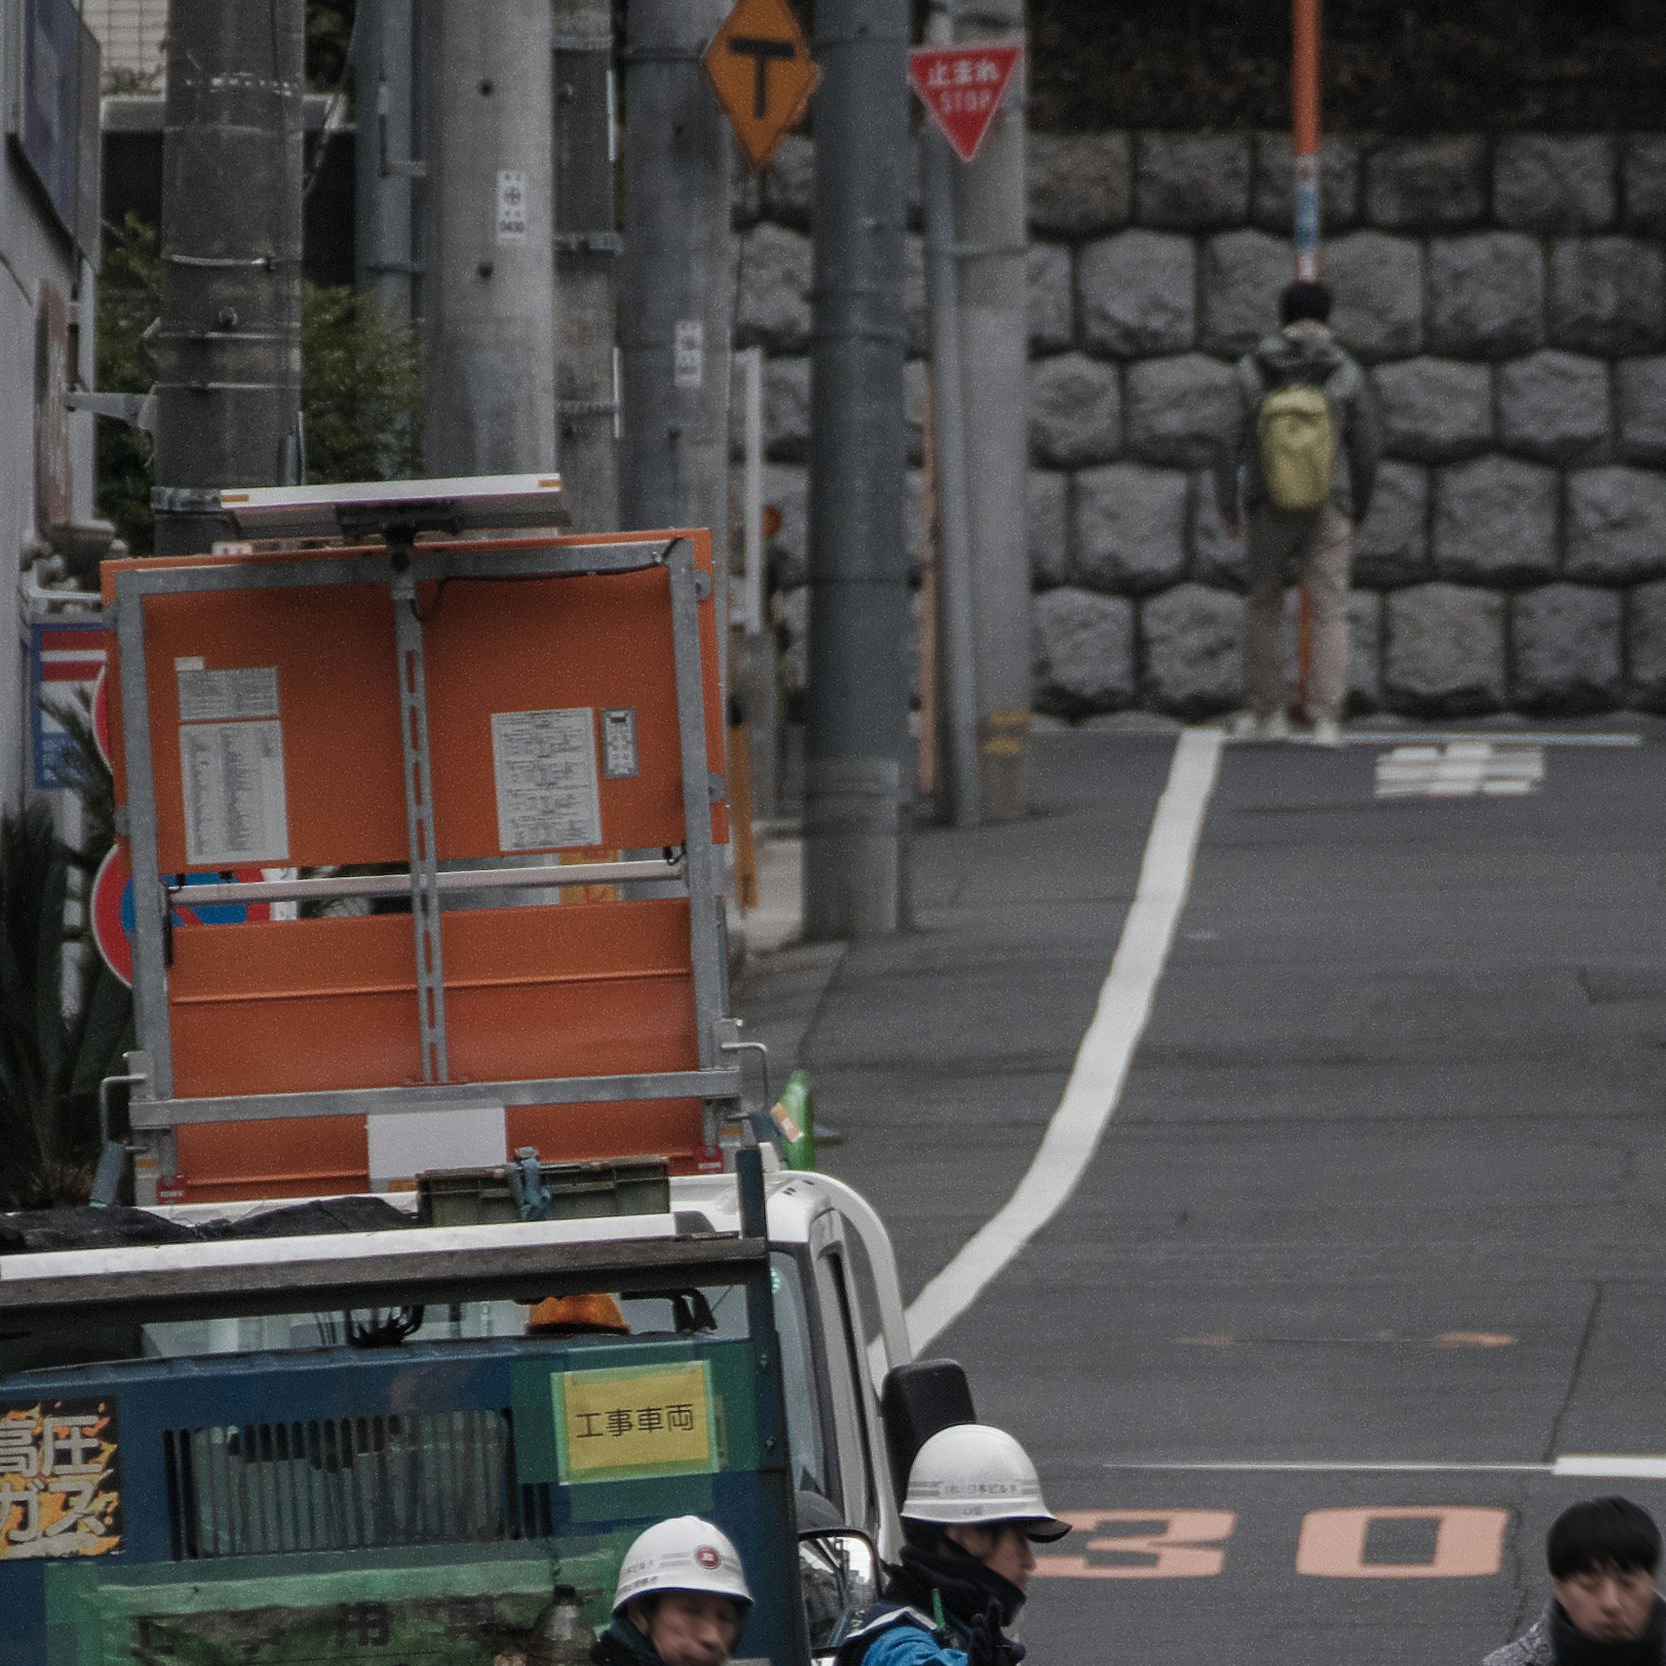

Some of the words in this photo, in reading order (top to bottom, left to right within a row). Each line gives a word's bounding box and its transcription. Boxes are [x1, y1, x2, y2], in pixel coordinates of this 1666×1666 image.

[927, 59, 1000, 86] 止まれ
[940, 88, 991, 114] STOP
[575, 1403, 694, 1439] 工事車両
